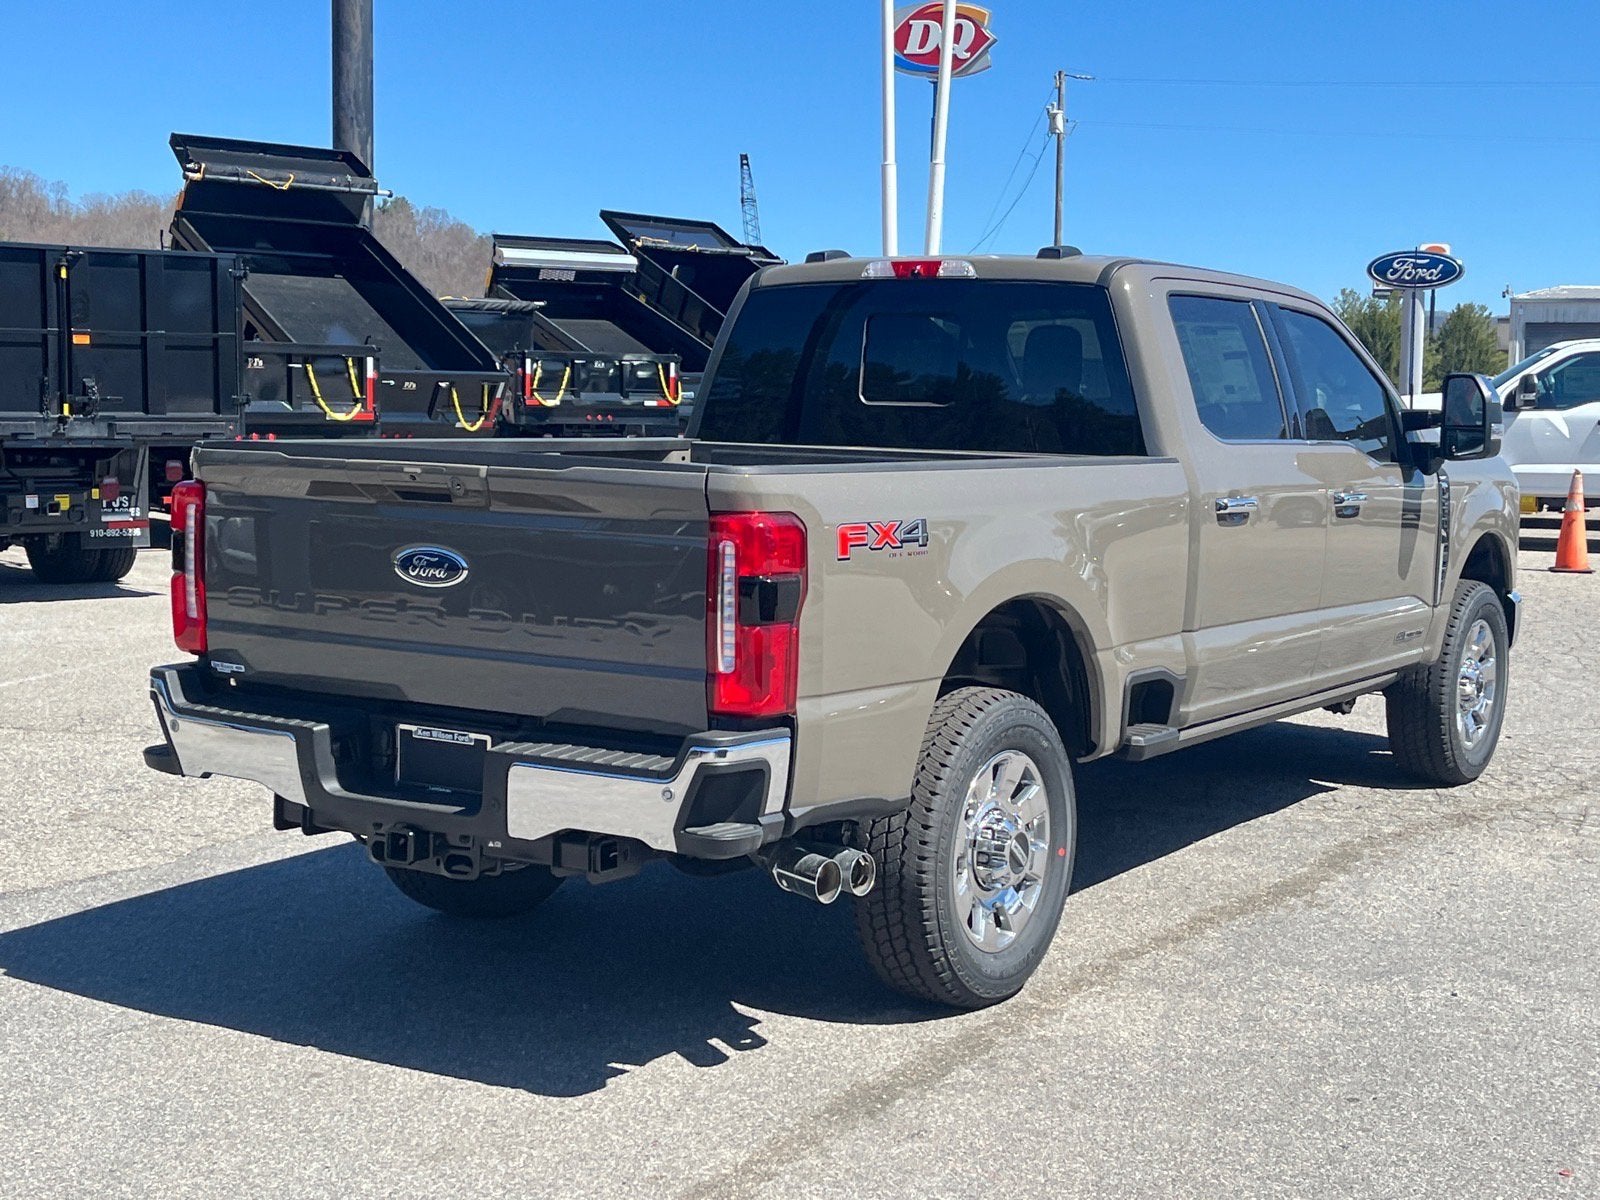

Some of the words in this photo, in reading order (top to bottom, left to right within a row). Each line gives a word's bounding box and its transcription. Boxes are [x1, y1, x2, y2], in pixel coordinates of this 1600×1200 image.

[904, 18, 976, 59] DQ
[1386, 258, 1444, 280] Ford
[836, 518, 929, 561] FX4
[408, 555, 449, 578] Ford
[417, 728, 431, 737] Ken
[431, 730, 453, 740] Wilson
[454, 733, 470, 742] Ford
